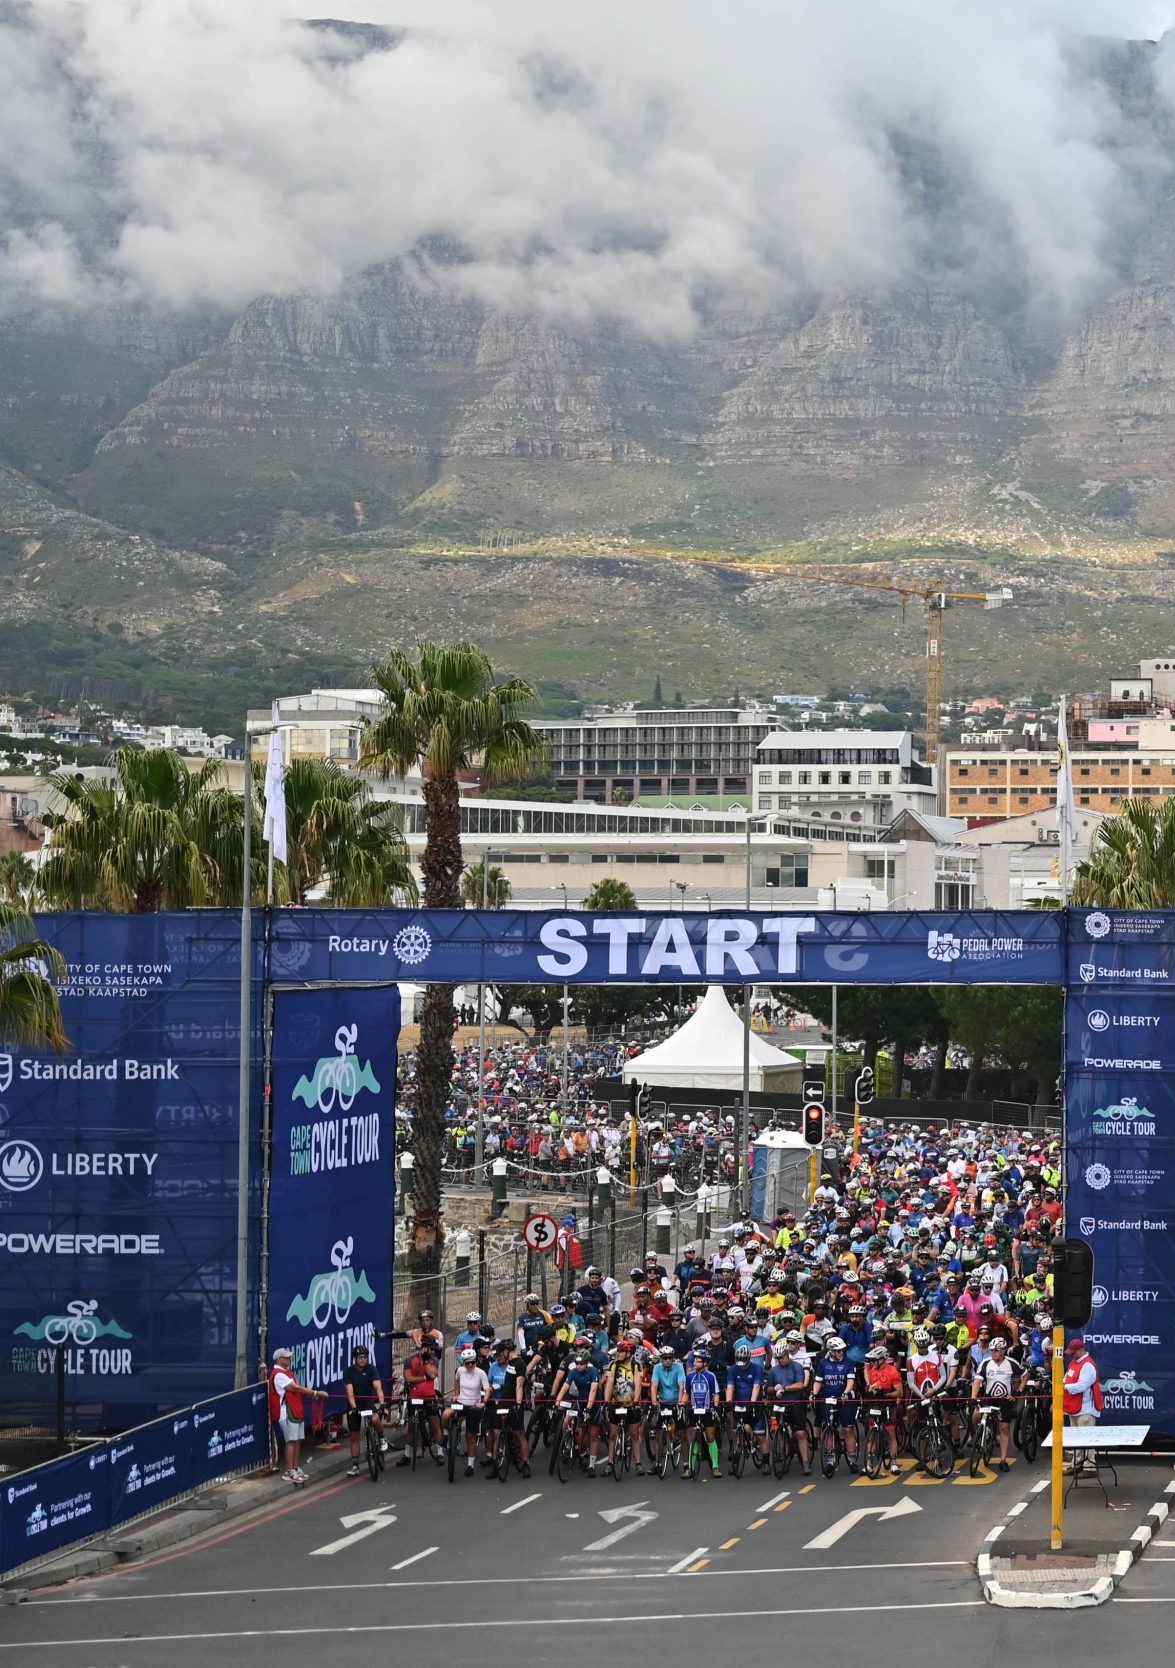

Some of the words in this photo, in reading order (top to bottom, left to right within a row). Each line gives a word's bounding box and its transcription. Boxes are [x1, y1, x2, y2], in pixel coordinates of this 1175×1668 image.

[328, 936, 389, 956] Rotary
[537, 918, 816, 976] START
[962, 938, 991, 952] PEDAL
[992, 938, 1024, 952] POWER
[85, 964, 100, 974] OF
[104, 964, 134, 974] CAPE
[137, 964, 172, 974] TOWN
[1098, 967, 1141, 977] Standard
[1144, 968, 1168, 978] Bank
[57, 976, 101, 985] ISIXEKO
[105, 976, 163, 985] SASEKAPA
[57, 988, 84, 997] STAD
[89, 988, 147, 997] KAAPSTAD
[1113, 1016, 1160, 1027] LIBERTY
[20, 1060, 117, 1080] Standard
[124, 1060, 180, 1080] Bank
[1084, 1058, 1161, 1069] POWERADE
[1106, 1122, 1131, 1135] CYCLE
[1133, 1122, 1156, 1136] TOUR
[290, 1124, 311, 1150] CAPE
[311, 1118, 348, 1173] CYCLE
[350, 1113, 380, 1166] TOUR
[52, 1153, 158, 1175] LIBERTY
[290, 1150, 311, 1176] TOWN
[1098, 1220, 1141, 1230] Standard
[1144, 1220, 1168, 1230] Bank
[1112, 1290, 1159, 1302] LIBERTY
[1083, 1334, 1159, 1345] POWERADE
[12, 1348, 37, 1360] CAPE
[12, 1360, 37, 1372] TOWN
[38, 1348, 85, 1374] CYLE
[90, 1348, 132, 1374] TOUR
[306, 1332, 344, 1390] CYCLE
[1104, 1396, 1130, 1409] CYCLE
[1132, 1396, 1154, 1409] TOUR
[51, 1498, 74, 1513] Partnering
[74, 1493, 83, 1504] with
[51, 1514, 67, 1526] clients
